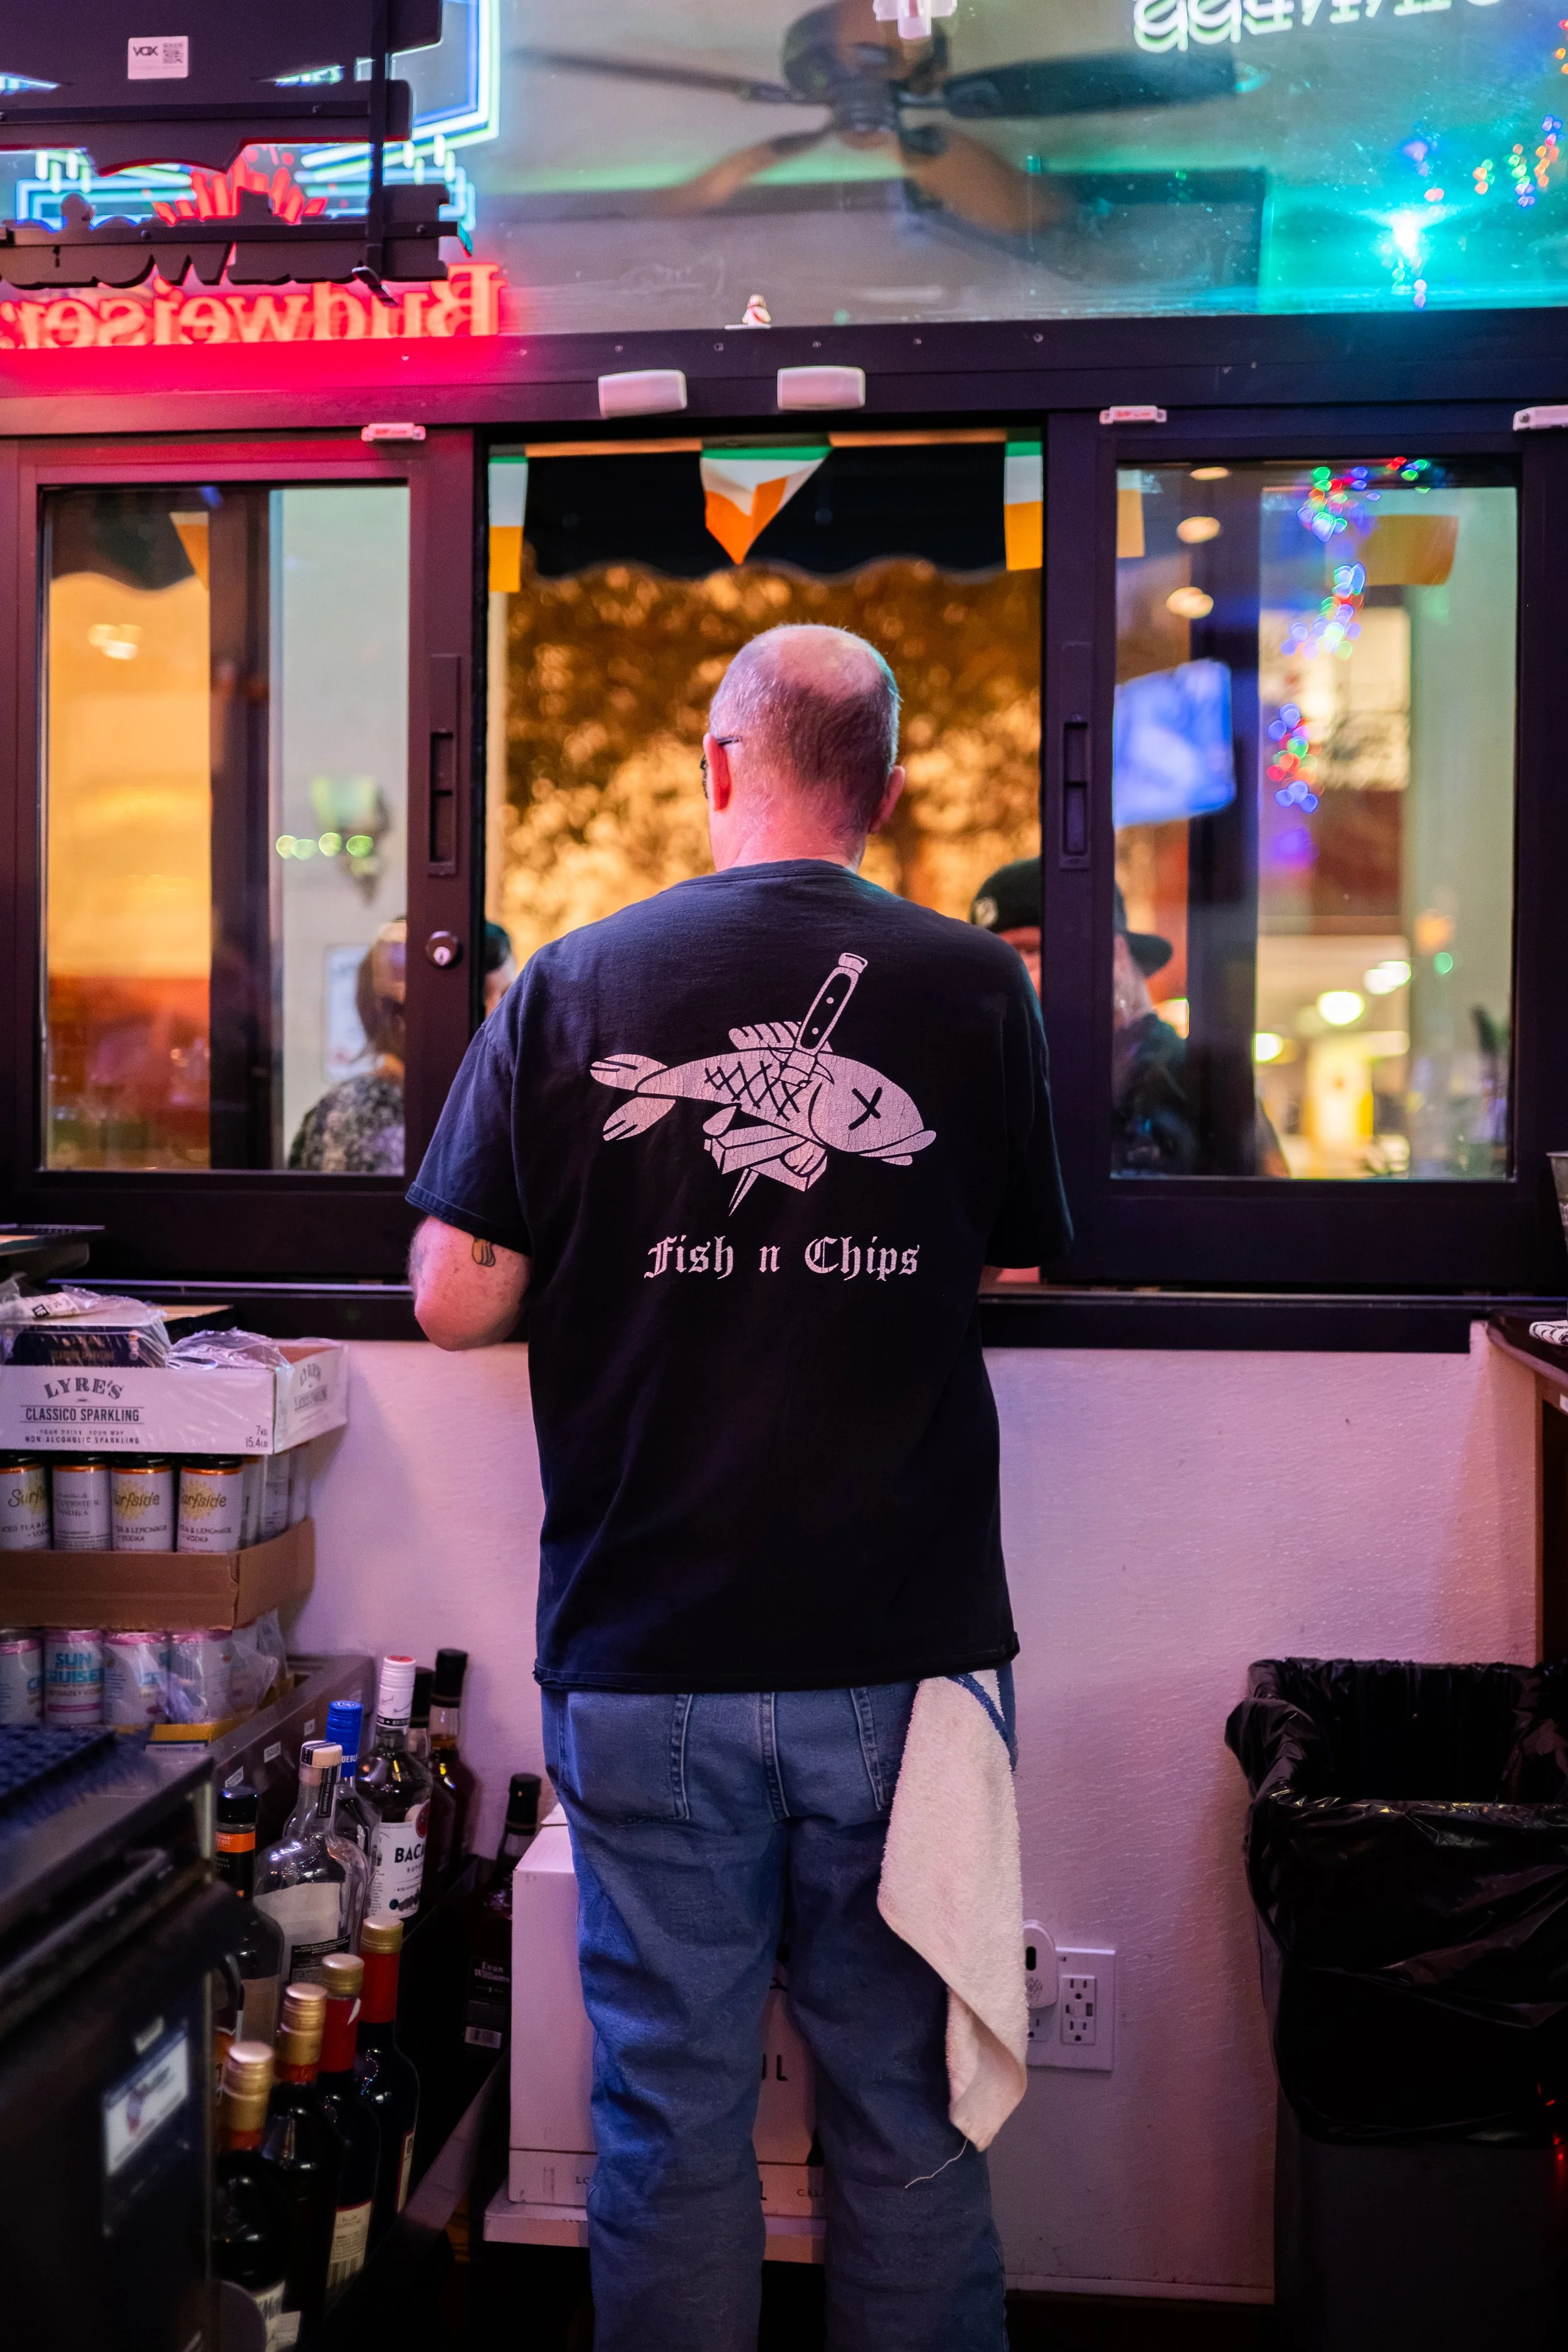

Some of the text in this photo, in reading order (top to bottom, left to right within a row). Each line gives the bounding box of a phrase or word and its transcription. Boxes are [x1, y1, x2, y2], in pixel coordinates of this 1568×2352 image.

[644, 1235, 920, 1281] Fish n Chips
[44, 1377, 125, 1399] LYRE'S
[26, 1407, 139, 1422] CLASSICO SPARKLING
[55, 1652, 92, 1665] SUN
